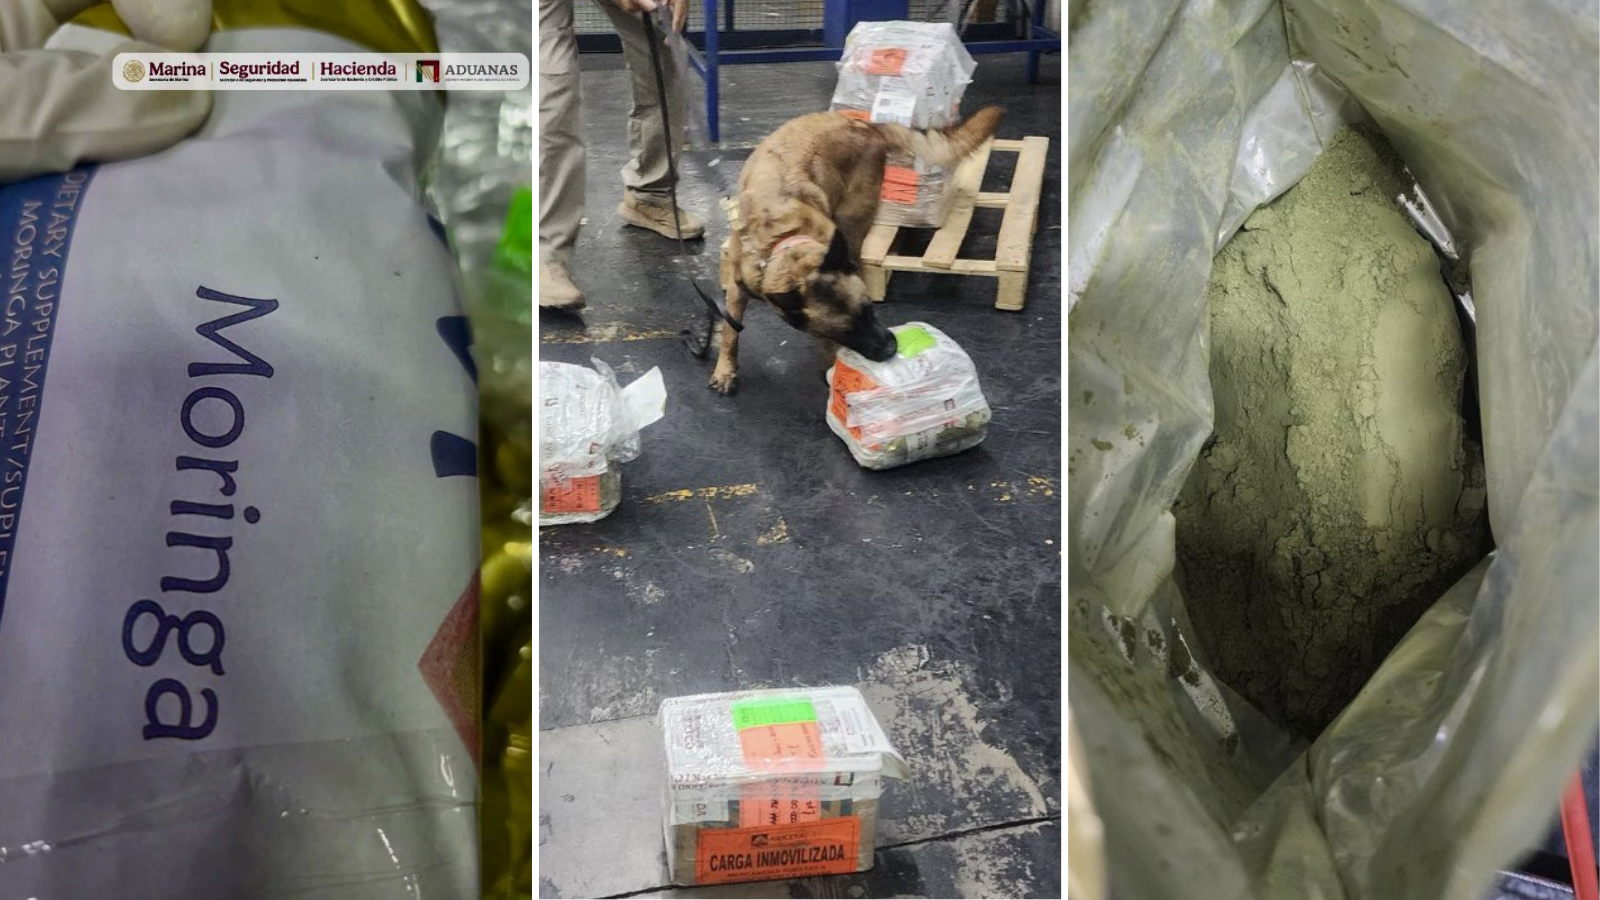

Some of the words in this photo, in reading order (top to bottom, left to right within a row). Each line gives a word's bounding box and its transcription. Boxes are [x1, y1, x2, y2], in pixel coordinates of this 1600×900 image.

[3, 198, 43, 337] MORINGA
[43, 171, 89, 258] DIETARY
[121, 284, 279, 741] Moringa
[709, 853, 753, 872] CARGA
[756, 843, 845, 868] INMOVILIZADA
